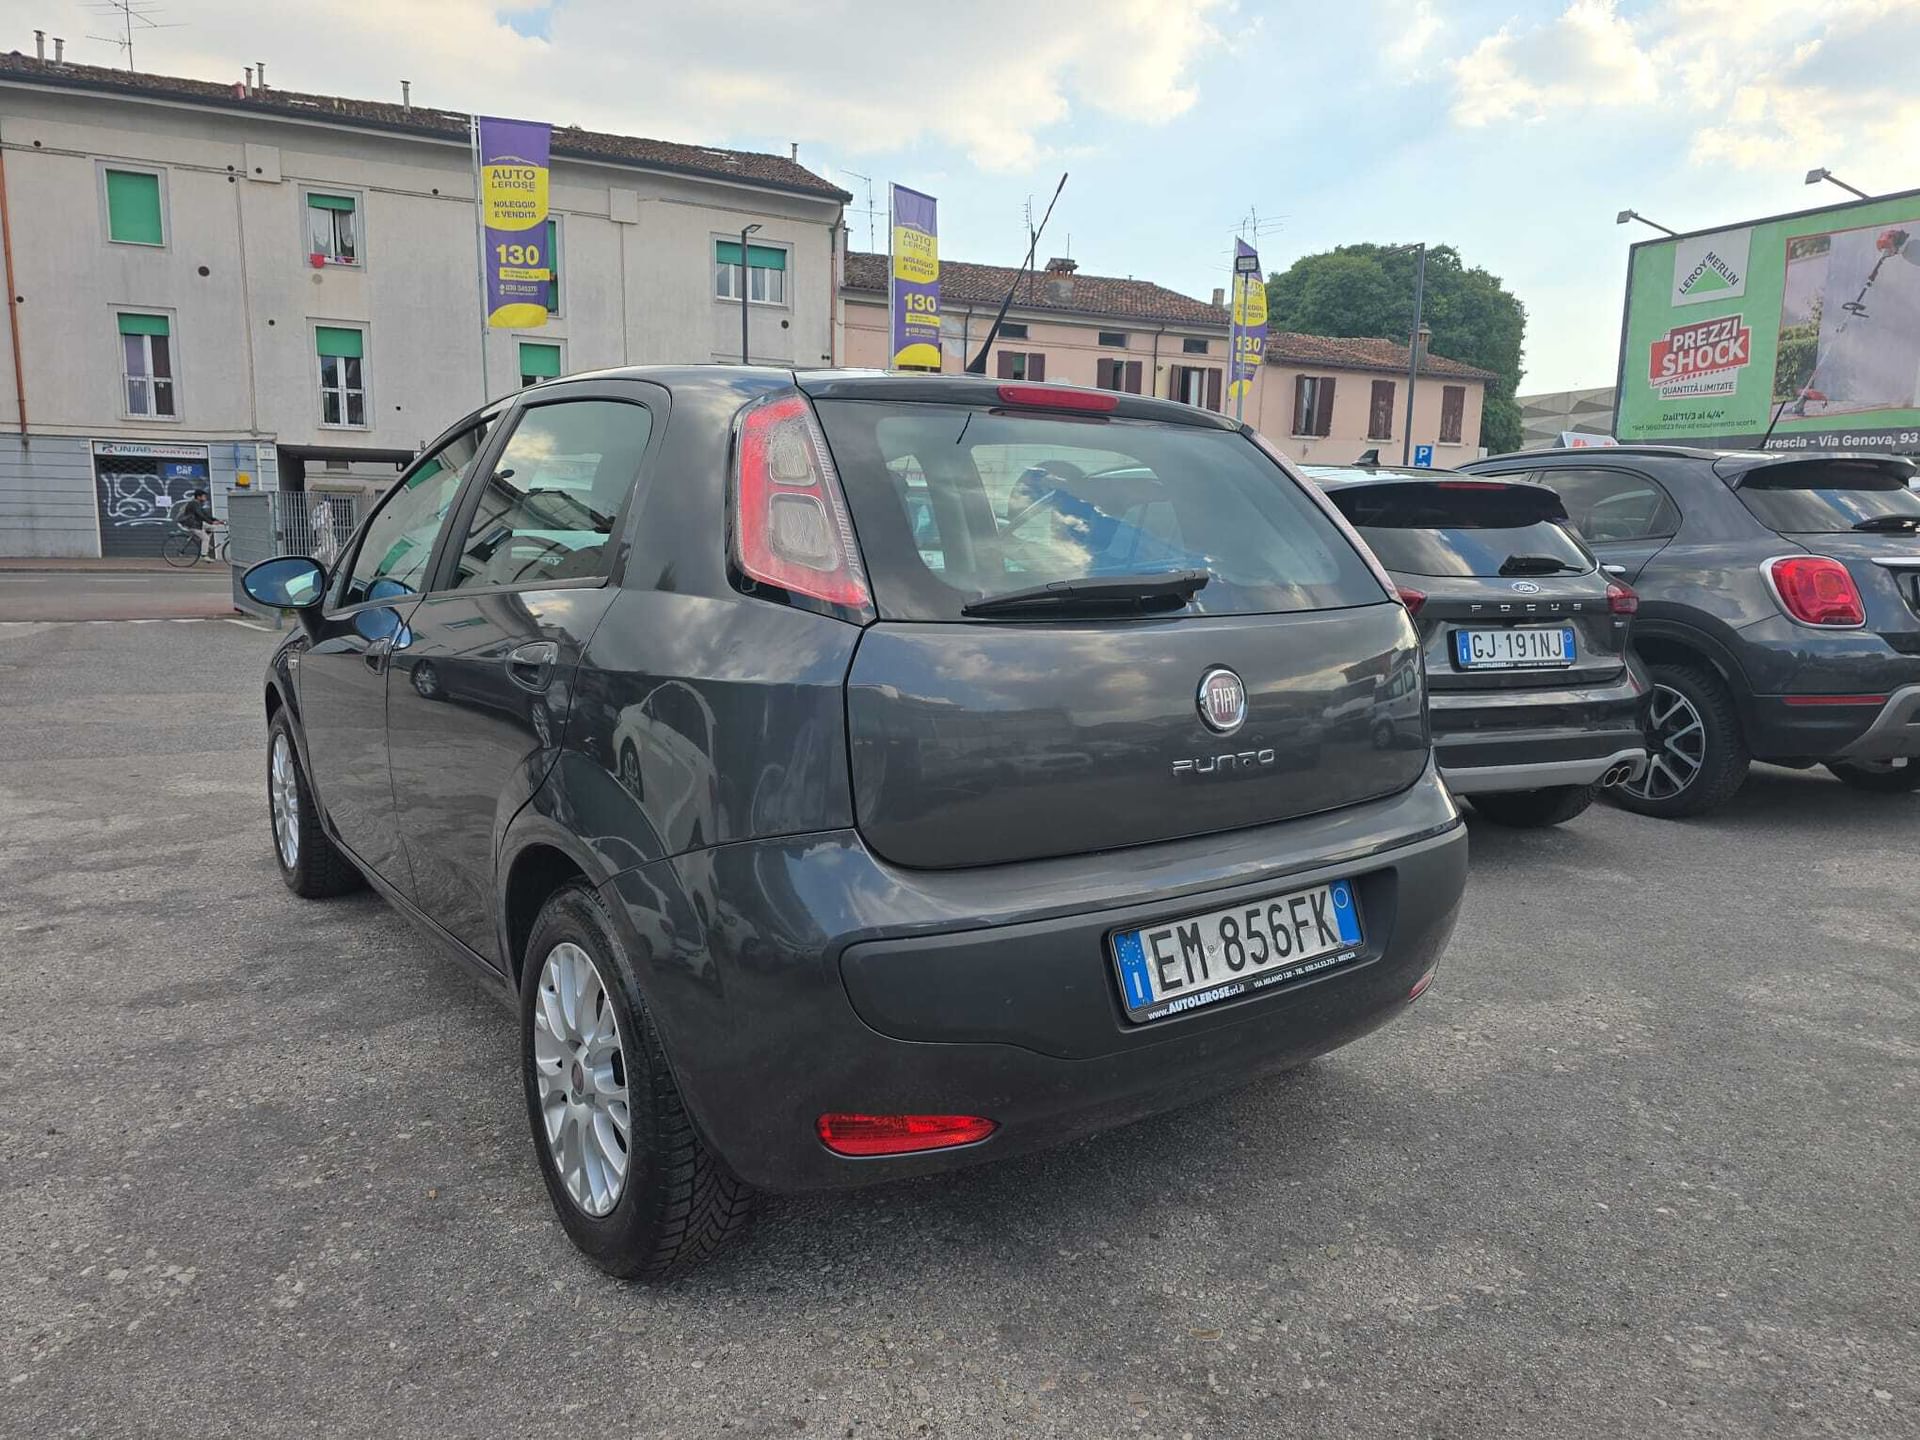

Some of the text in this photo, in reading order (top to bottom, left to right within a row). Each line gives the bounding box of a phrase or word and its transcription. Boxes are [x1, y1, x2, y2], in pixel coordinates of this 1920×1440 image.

[492, 169, 536, 180] AUTO
[491, 180, 536, 189] LEROSE
[493, 200, 536, 208] NOLEGGIO
[501, 210, 537, 219] VENDITA
[903, 231, 931, 247] AUTO
[496, 244, 539, 265] 130
[1679, 259, 1707, 294] LEROY
[1705, 251, 1740, 286] MERLIN
[904, 293, 936, 312] 130
[1235, 335, 1261, 352] 130
[1672, 318, 1739, 352] PREZZI
[1661, 335, 1746, 376] SHOCK
[1662, 381, 1735, 395] QUANTITÀ LIMITATE
[1662, 411, 1696, 421] Dall'11/3
[1697, 411, 1705, 420] al
[1818, 433, 1840, 447] Via
[1842, 433, 1896, 447] Genova,
[1899, 432, 1918, 444] 93
[1418, 447, 1429, 459] P
[1470, 603, 1582, 613] FOCUS
[1472, 631, 1562, 658] GJ 191NJ
[1212, 686, 1236, 714] FIAT
[1172, 748, 1275, 777] PUNTO
[1149, 890, 1338, 992] EM 856FK
[1132, 971, 1144, 999] I
[1263, 973, 1283, 985] MILANO
